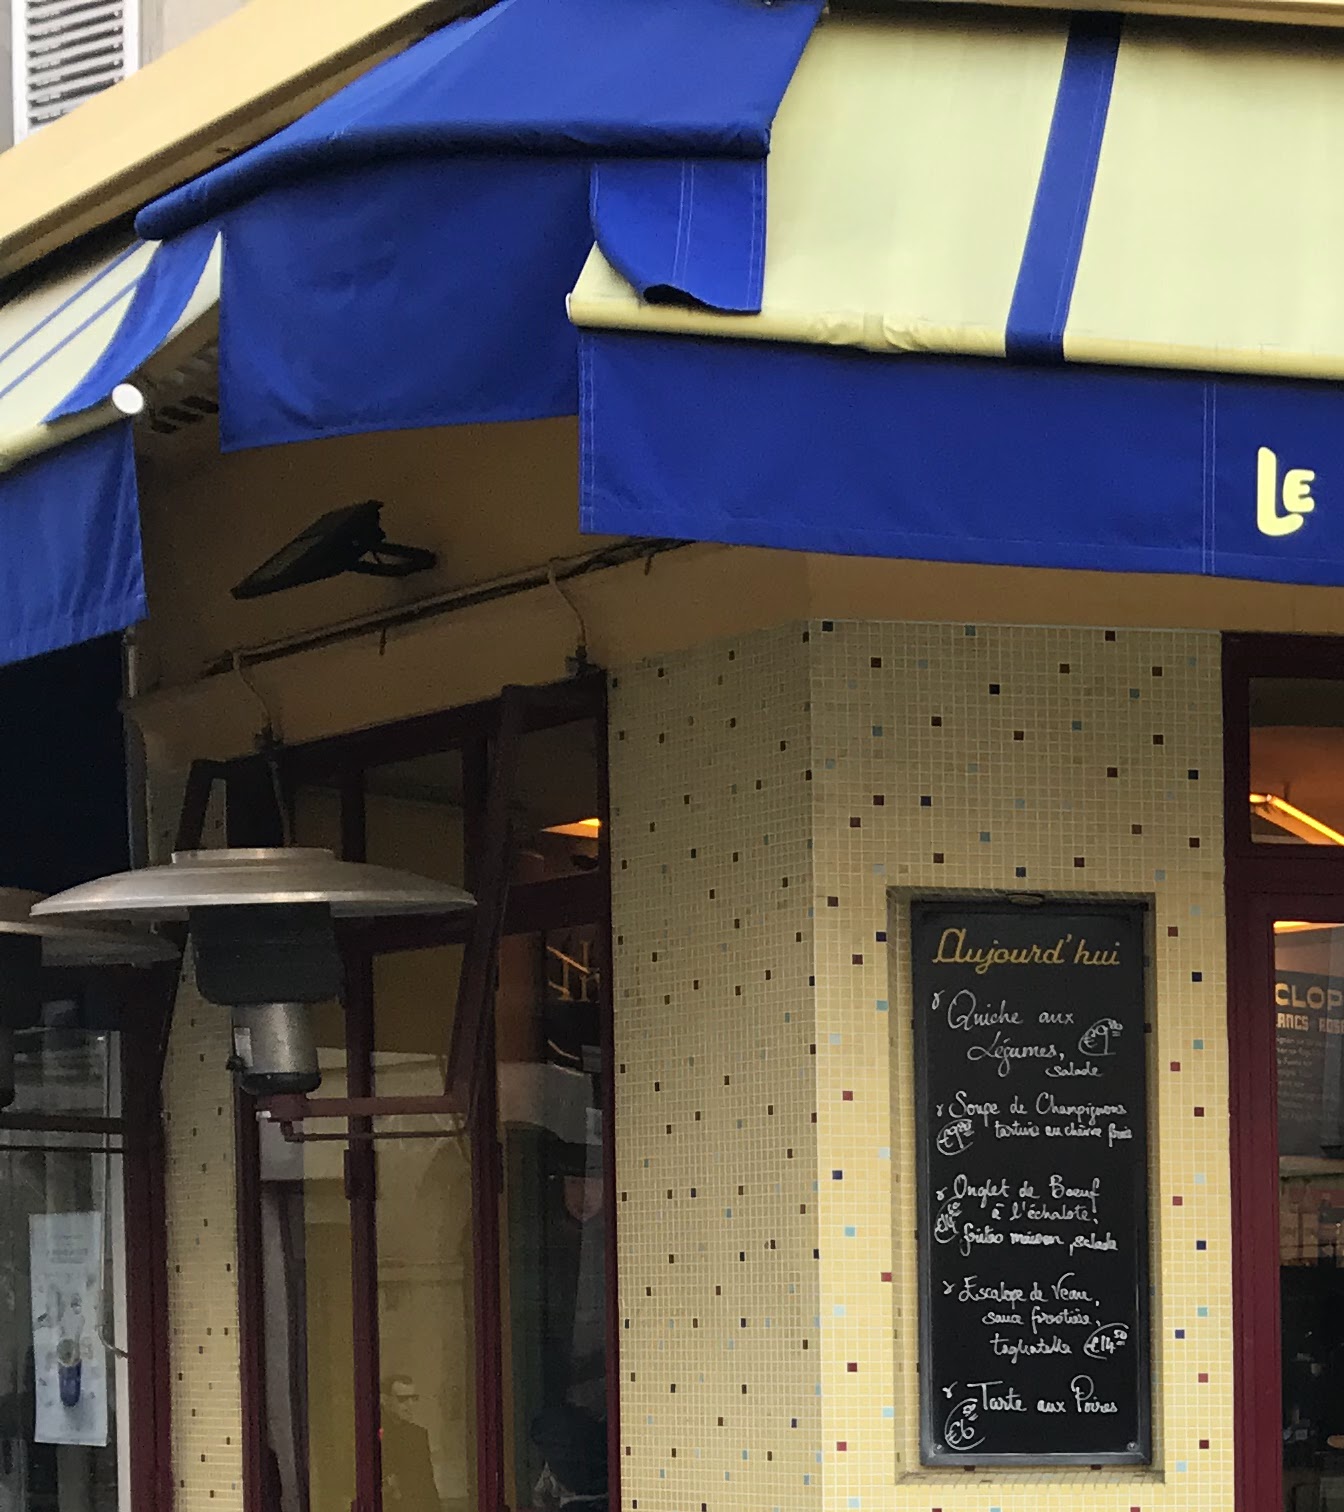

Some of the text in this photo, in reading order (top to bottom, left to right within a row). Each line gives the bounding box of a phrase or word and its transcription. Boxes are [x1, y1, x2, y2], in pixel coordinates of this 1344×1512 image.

[932, 927, 1120, 974] Aujourd'hui
[947, 989, 1074, 1031] Quiche aux
[1276, 1012, 1309, 1032] ANCS
[949, 1090, 1127, 1127] Soupe de Champignons
[954, 1174, 1010, 1208] Onglet
[1019, 1181, 1041, 1199] de
[992, 1203, 1005, 1220] à
[959, 1276, 1026, 1309] Escalope
[1030, 1282, 1049, 1301] de
[967, 1374, 1118, 1413] Tarte aux Poires
